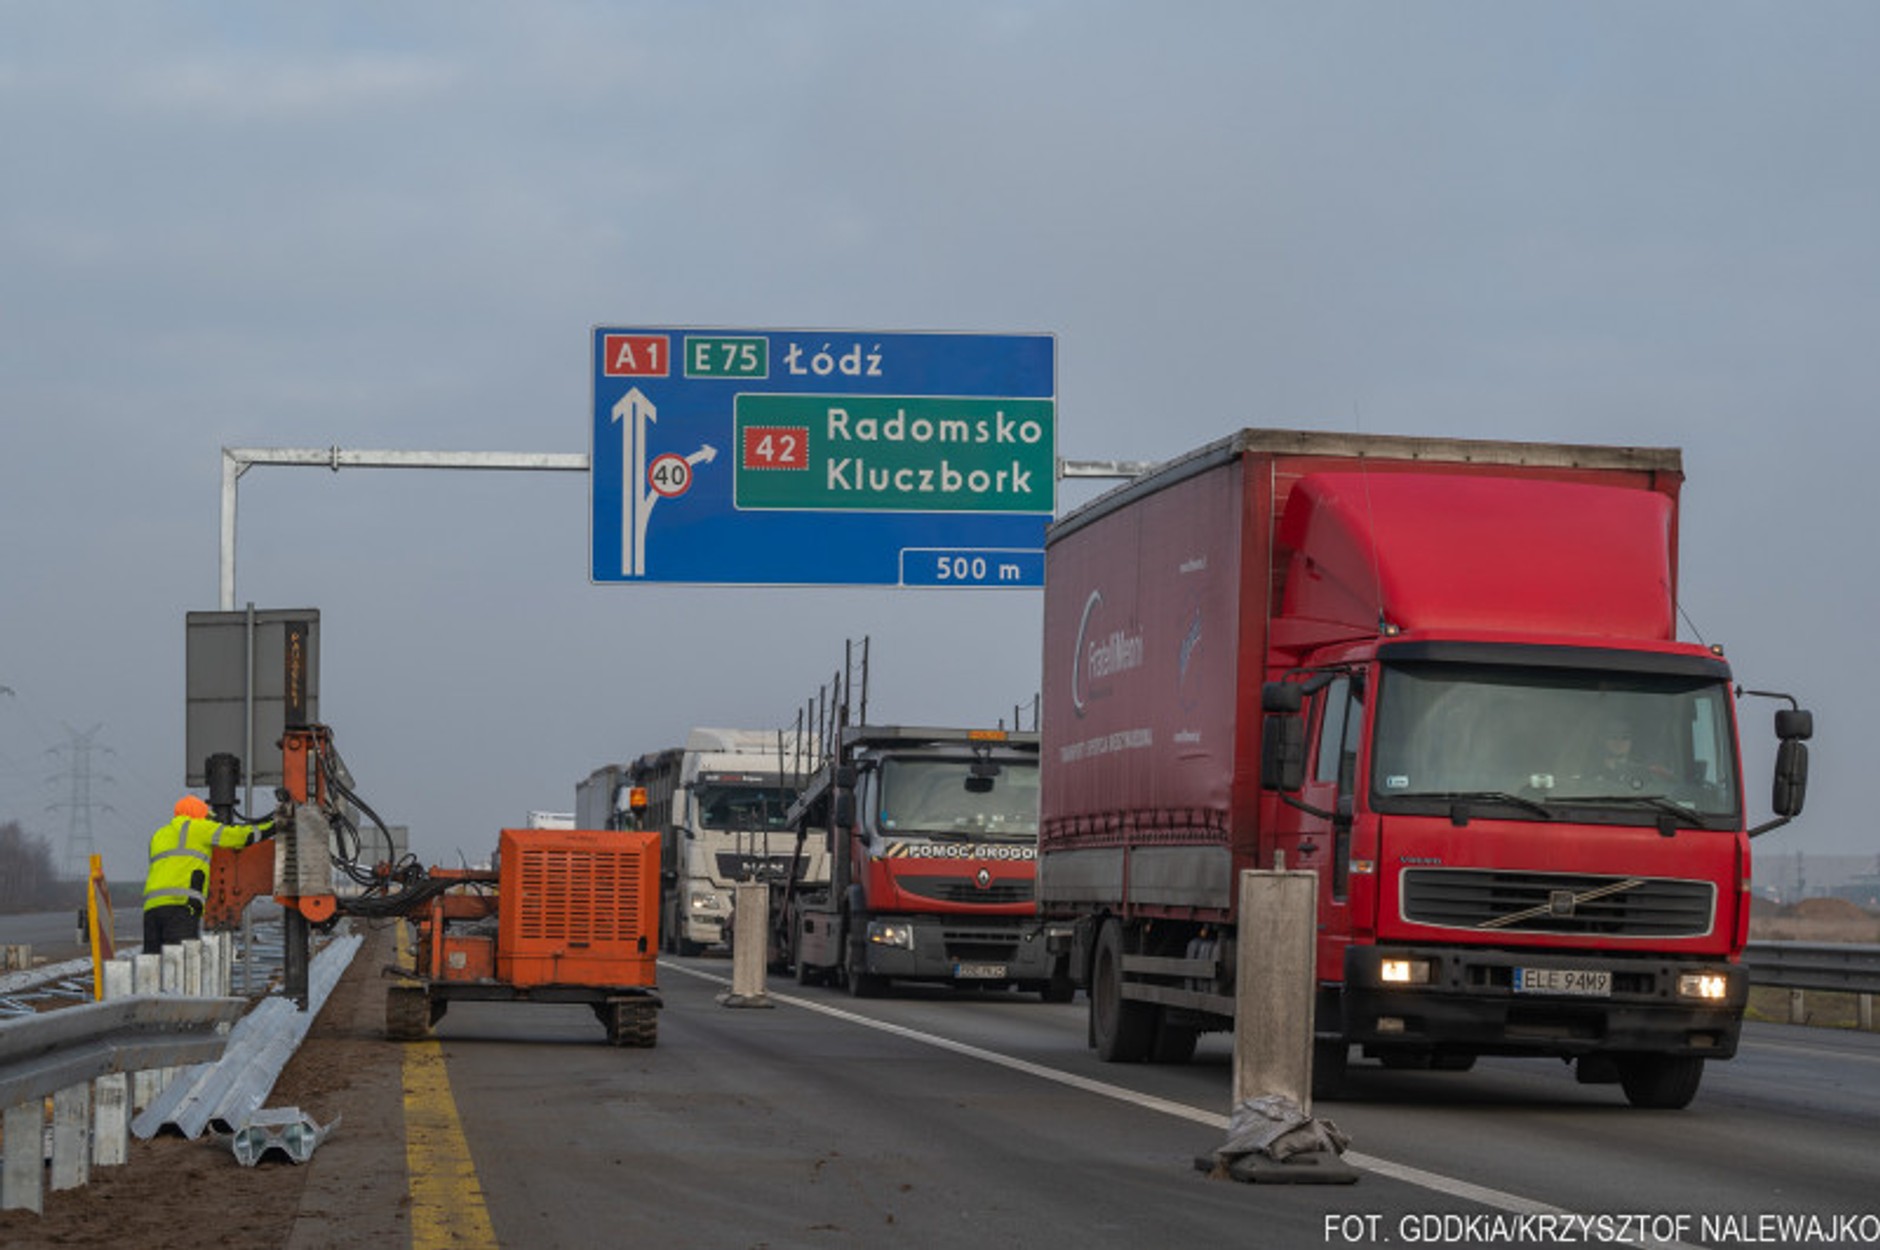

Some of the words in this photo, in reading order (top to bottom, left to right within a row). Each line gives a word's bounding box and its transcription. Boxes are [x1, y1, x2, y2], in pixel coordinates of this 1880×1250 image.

[695, 343, 712, 371] E
[721, 344, 758, 371] 75
[783, 343, 883, 376] Łódź
[827, 408, 1042, 444] Radomsko
[756, 434, 796, 462] 42
[653, 465, 686, 486] 40
[827, 458, 1032, 493] Kluczbork
[936, 556, 987, 580] 500
[999, 563, 1020, 580] m
[909, 845, 968, 858] POMOC
[1524, 970, 1560, 989] ELE
